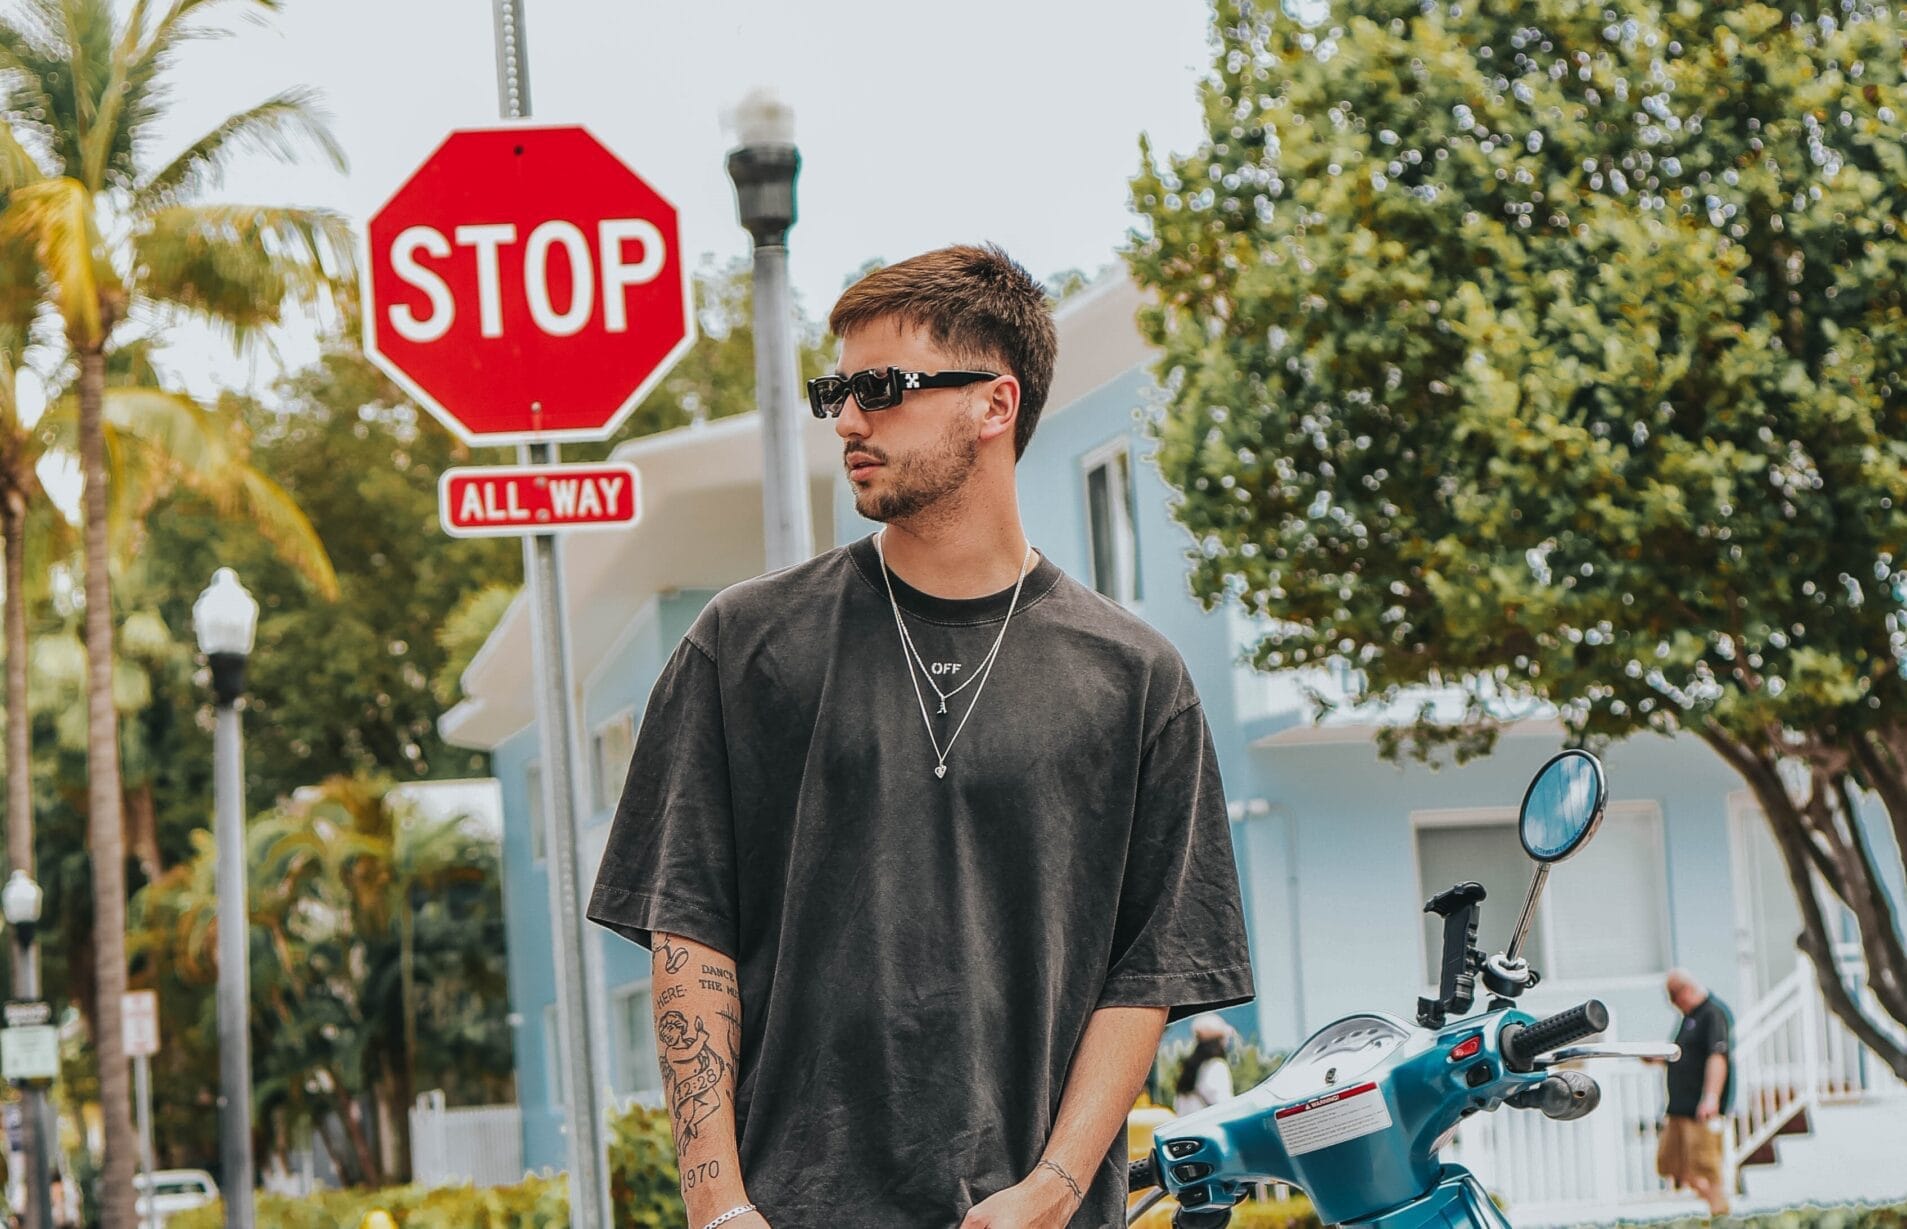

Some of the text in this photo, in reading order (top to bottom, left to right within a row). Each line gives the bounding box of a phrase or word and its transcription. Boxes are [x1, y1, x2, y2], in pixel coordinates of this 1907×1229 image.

[388, 218, 667, 344] STOP
[459, 477, 624, 521] ALL WAY
[931, 662, 962, 675] OFF
[698, 979, 723, 992] THE
[701, 964, 735, 982] DANCE
[677, 1068, 717, 1101] 12:28
[682, 1160, 720, 1193] 1970
